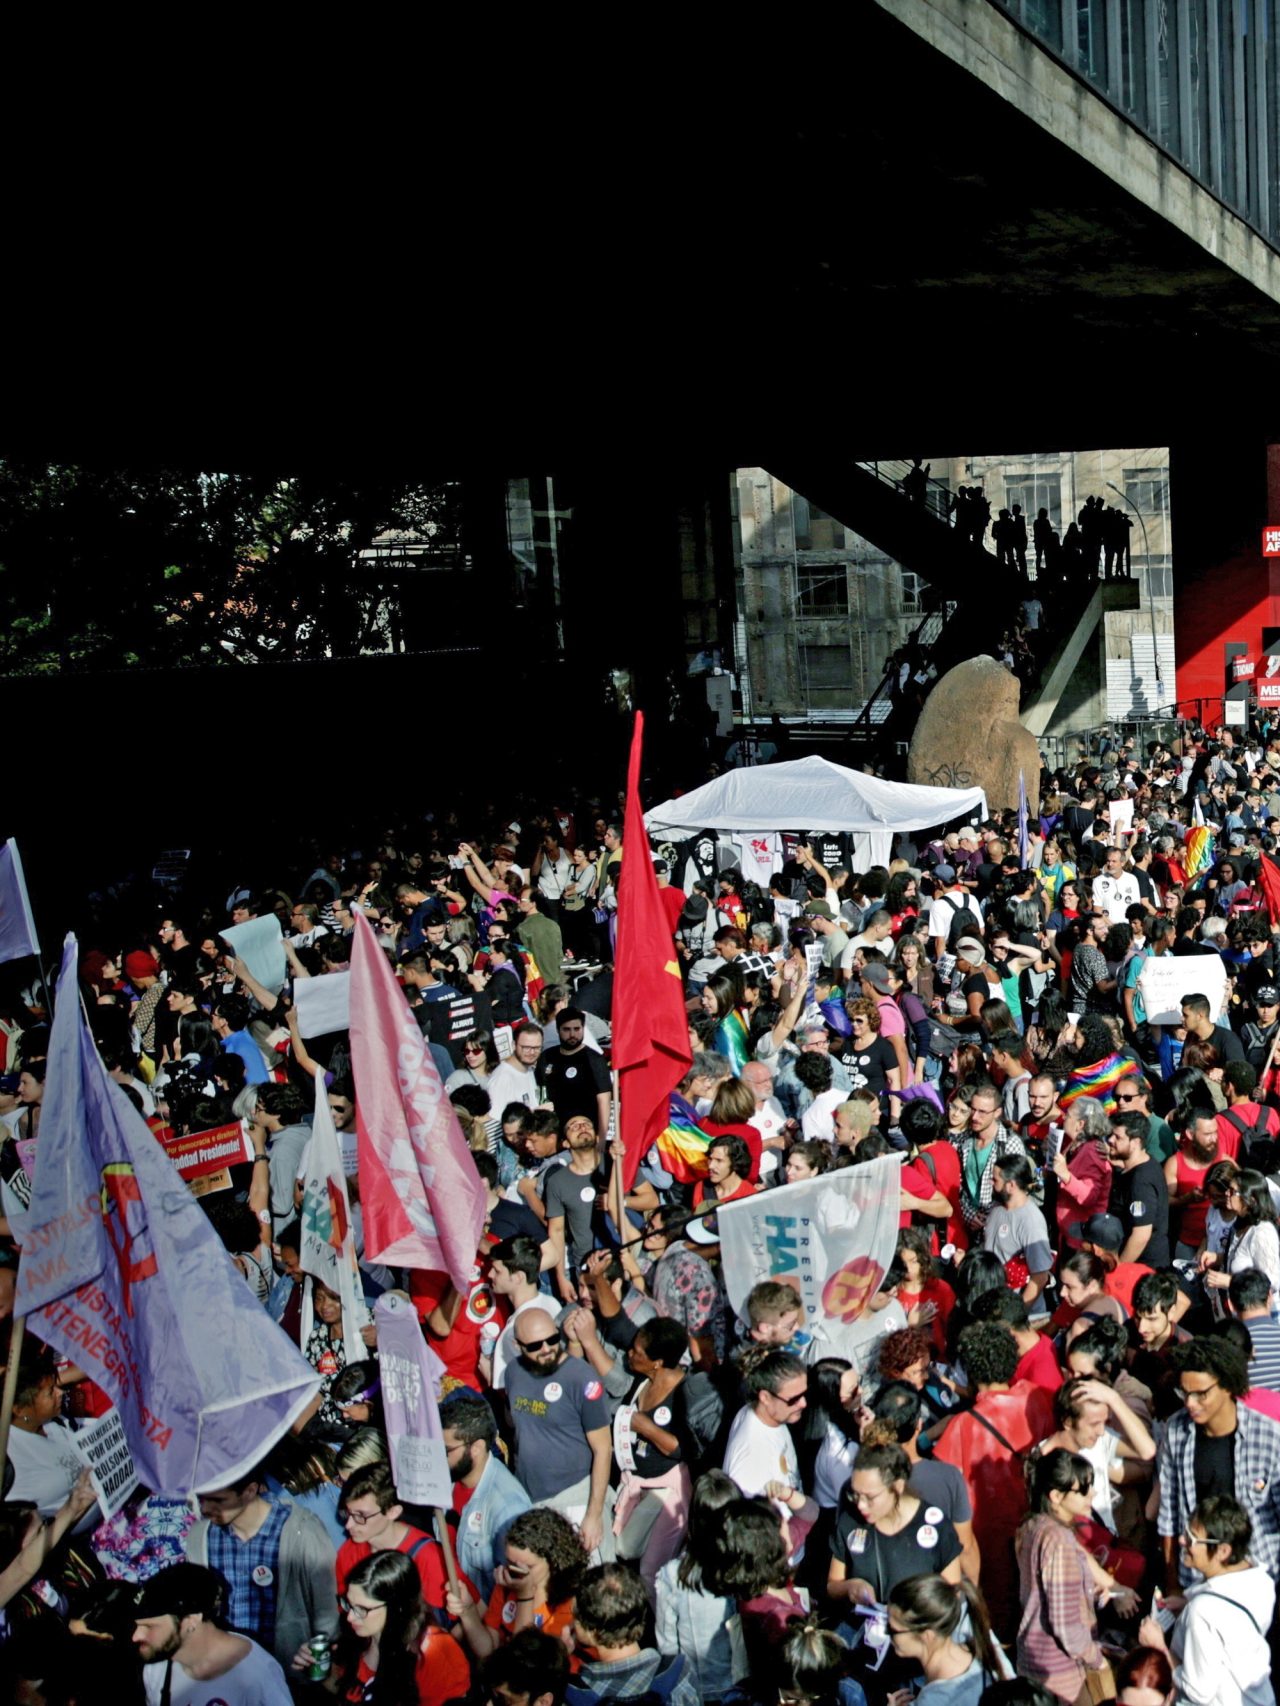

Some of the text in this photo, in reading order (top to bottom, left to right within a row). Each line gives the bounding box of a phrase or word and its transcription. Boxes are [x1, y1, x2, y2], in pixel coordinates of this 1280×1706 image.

[199, 1138, 241, 1163] Presidente!
[77, 1421, 113, 1450] MULHERES
[87, 1440, 106, 1463] POR
[94, 1444, 129, 1481] BOLSONA
[102, 1458, 134, 1500] HADDAD
